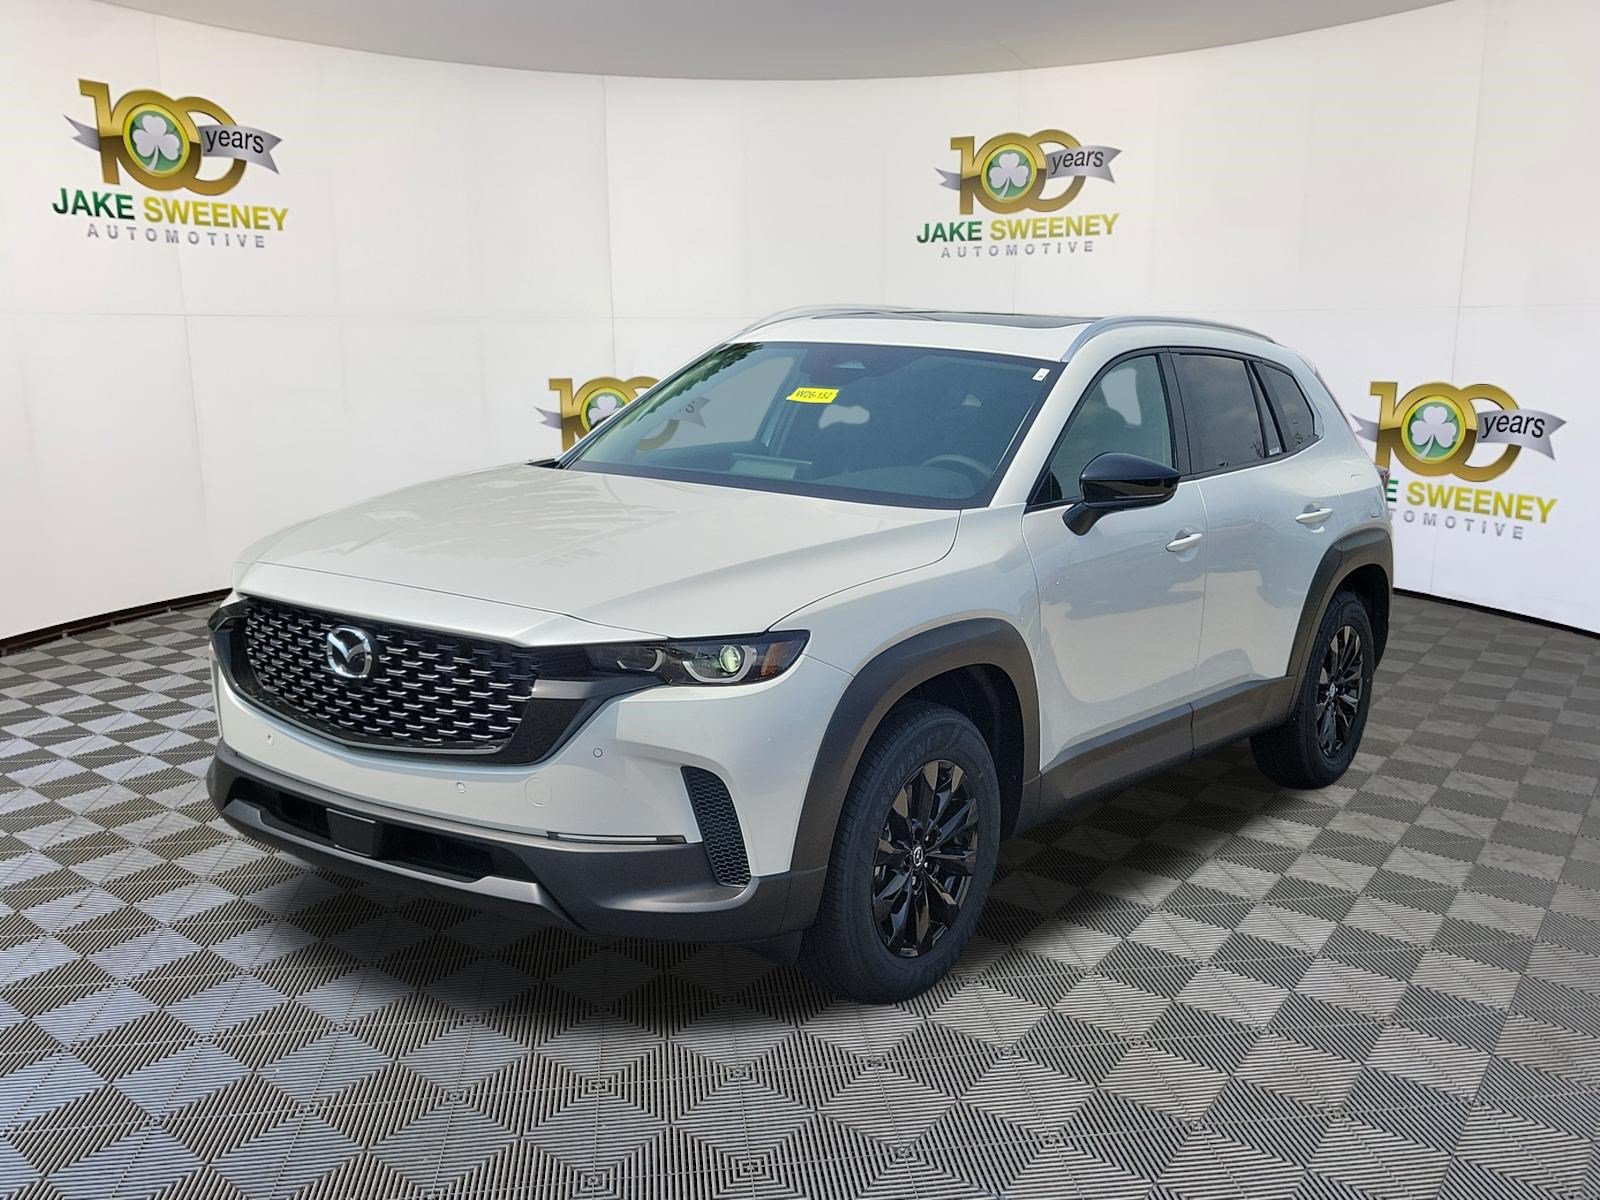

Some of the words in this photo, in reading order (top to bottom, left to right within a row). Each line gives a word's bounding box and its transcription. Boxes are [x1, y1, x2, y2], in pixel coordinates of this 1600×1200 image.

[78, 79, 247, 196] 100
[205, 129, 264, 154] years
[950, 129, 1086, 215] 100
[1051, 150, 1104, 174] years
[52, 188, 135, 220] JAKE
[143, 196, 288, 231] SWEENEY
[917, 221, 983, 243] JAKE
[990, 213, 1120, 240] SWEENEY
[87, 223, 265, 248] AUTOMOTIVE
[941, 241, 1094, 258] AUTOMOTIVE
[1370, 381, 1522, 482] 100
[1482, 414, 1545, 438] years
[1388, 508, 1524, 540] TOMOTIVE
[1406, 481, 1558, 524] SWEENEY
